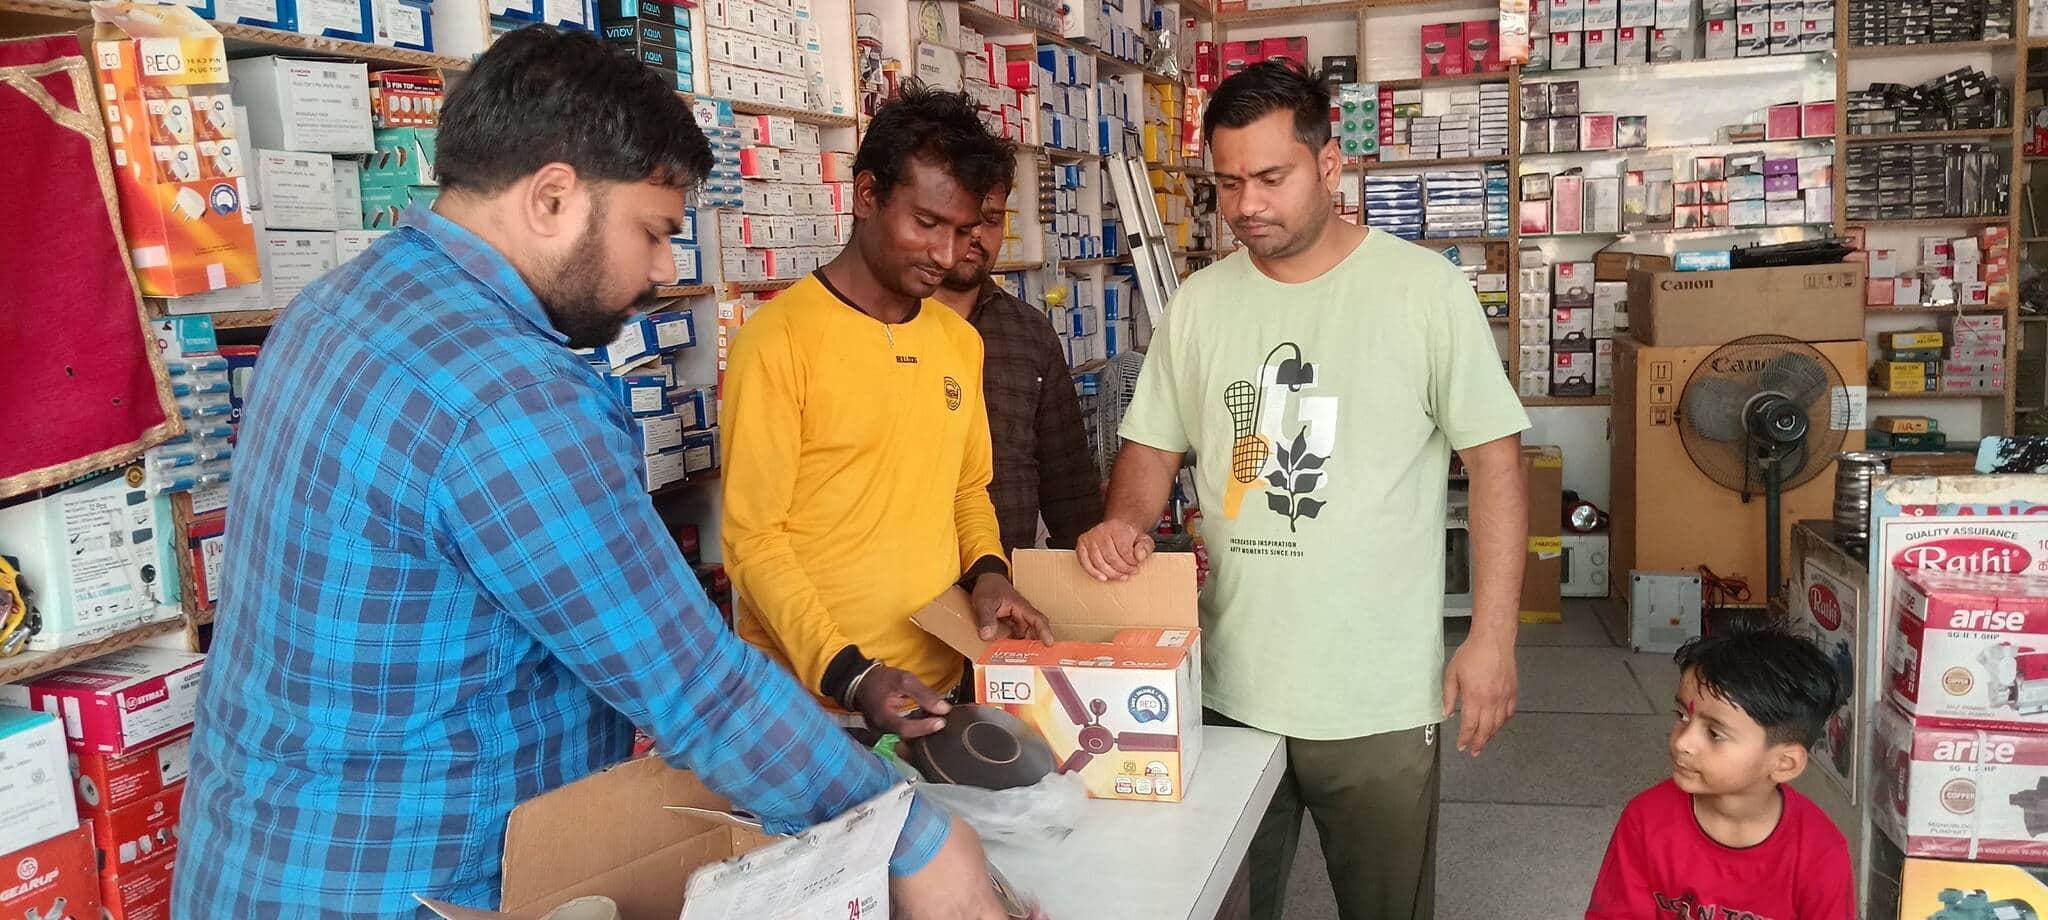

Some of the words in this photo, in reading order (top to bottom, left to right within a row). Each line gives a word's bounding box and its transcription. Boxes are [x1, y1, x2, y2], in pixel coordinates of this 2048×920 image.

[606, 27, 634, 39] AQUA
[146, 54, 181, 72] REO
[1660, 278, 1714, 292] Canon
[1905, 527, 1950, 541] QUALITY
[1953, 527, 2019, 540] ASSURANCE
[1257, 540, 1297, 548] INSPIRATION
[1904, 546, 2013, 573] Rathi
[1949, 608, 2026, 631] arise
[989, 680, 1031, 700] REO
[1139, 699, 1158, 709] REO
[1928, 820, 1973, 830] MONOBLOC
[848, 897, 860, 920] 24
